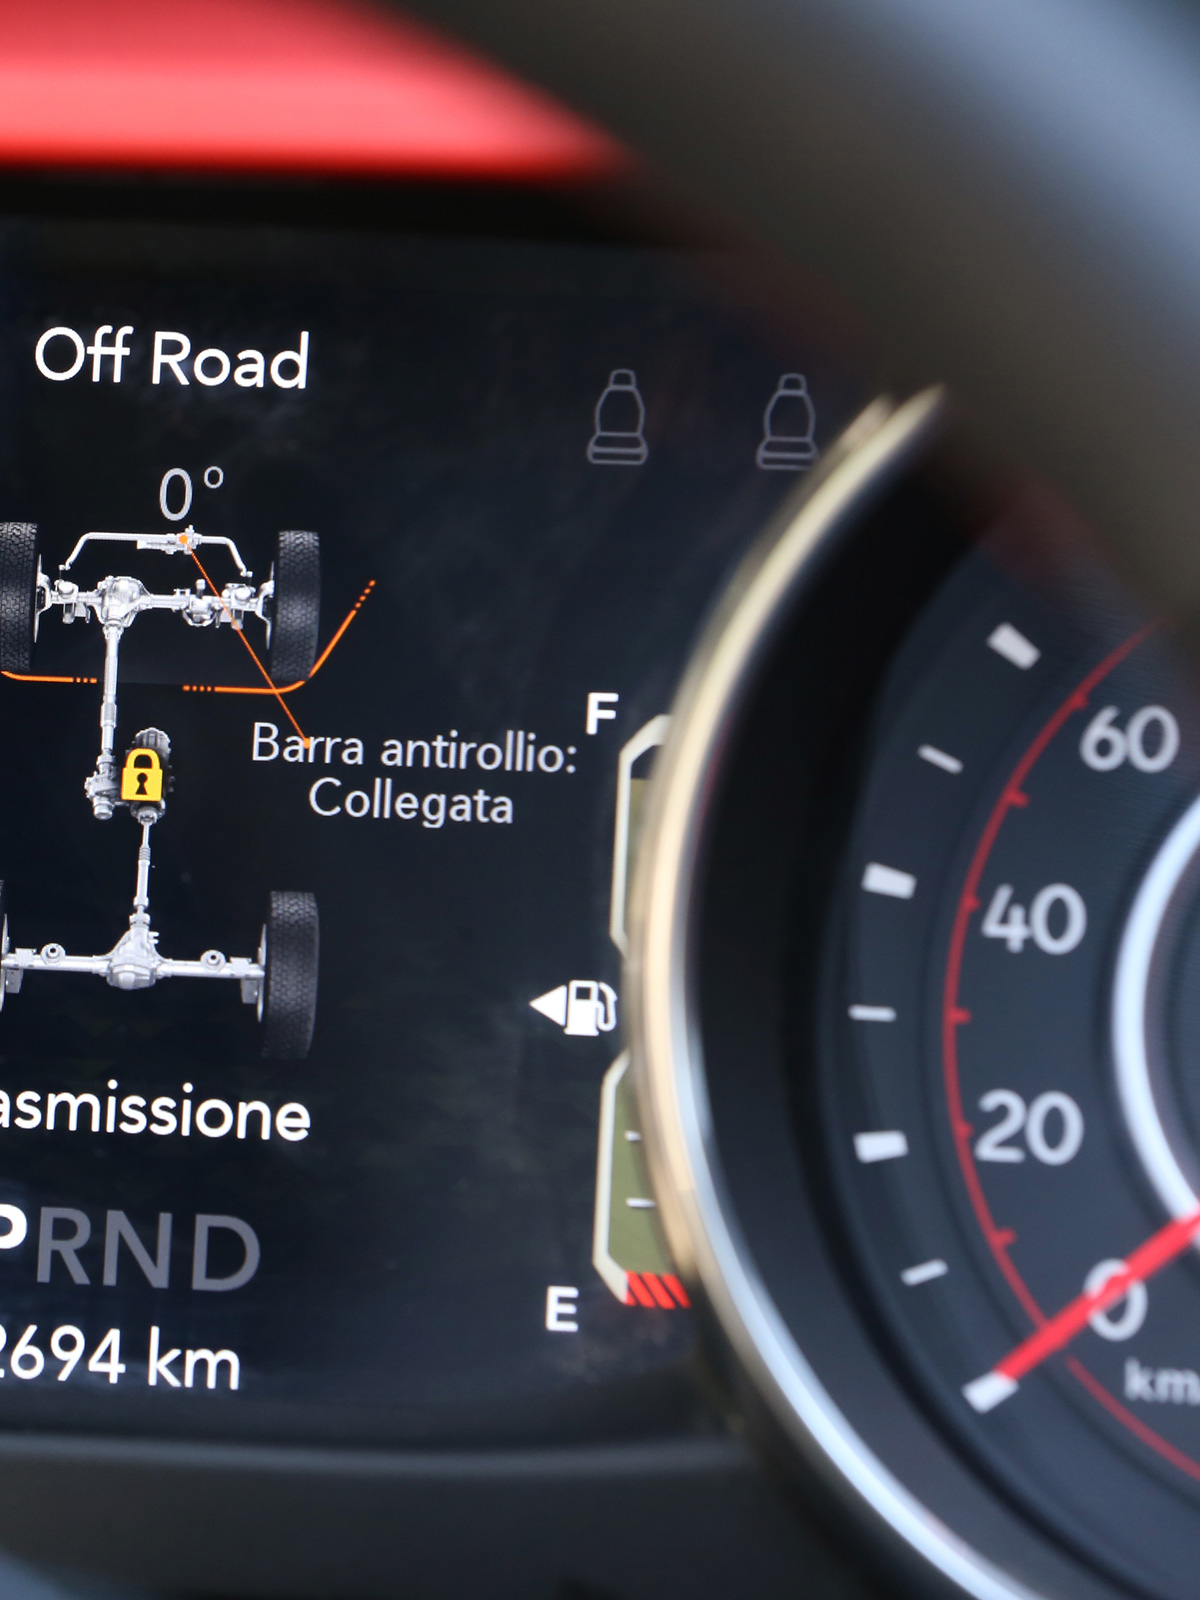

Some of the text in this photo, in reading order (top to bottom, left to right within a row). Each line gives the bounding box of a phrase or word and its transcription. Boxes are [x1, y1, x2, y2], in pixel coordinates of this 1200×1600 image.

[34, 325, 310, 390] Off Road
[585, 692, 620, 736] F
[1078, 704, 1180, 773] 60
[251, 721, 578, 774] Barra antirollio:
[308, 776, 514, 829] Collegata
[981, 883, 1088, 955] 40
[975, 1089, 1085, 1166] 20
[545, 1286, 579, 1333] E
[1083, 1257, 1149, 1342] 0
[147, 1325, 241, 1391] km
